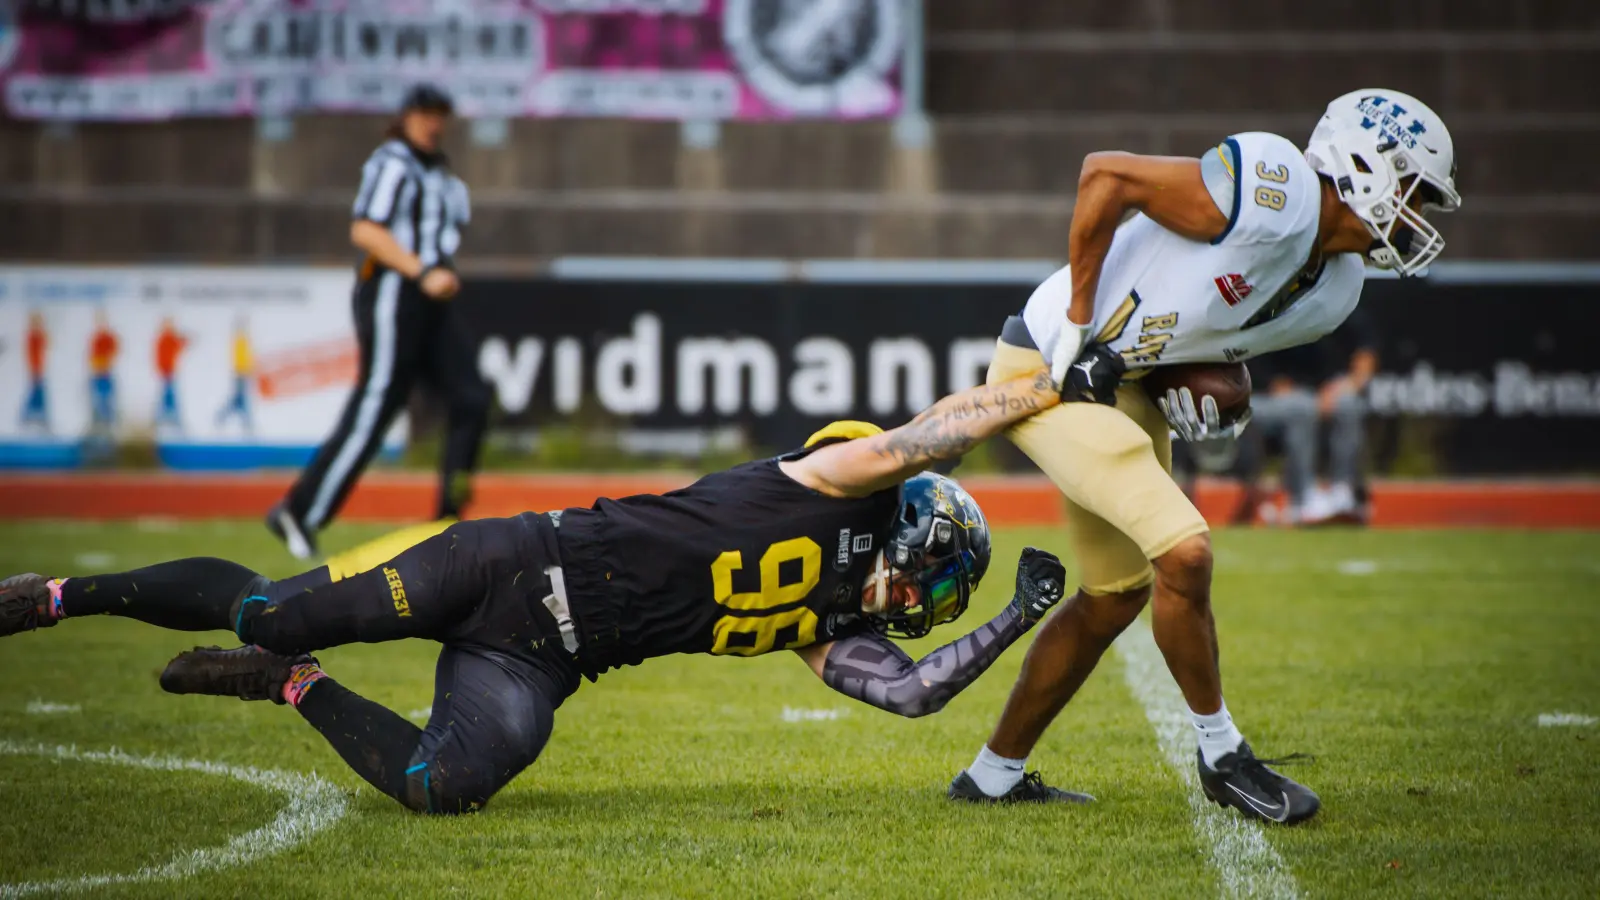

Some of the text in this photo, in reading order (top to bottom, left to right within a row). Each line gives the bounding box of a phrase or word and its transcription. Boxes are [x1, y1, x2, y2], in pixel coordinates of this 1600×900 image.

[1381, 113, 1417, 149] WINGS
[1254, 160, 1289, 212] 38
[838, 528, 851, 563] KUNERT
[711, 536, 822, 656] 96
